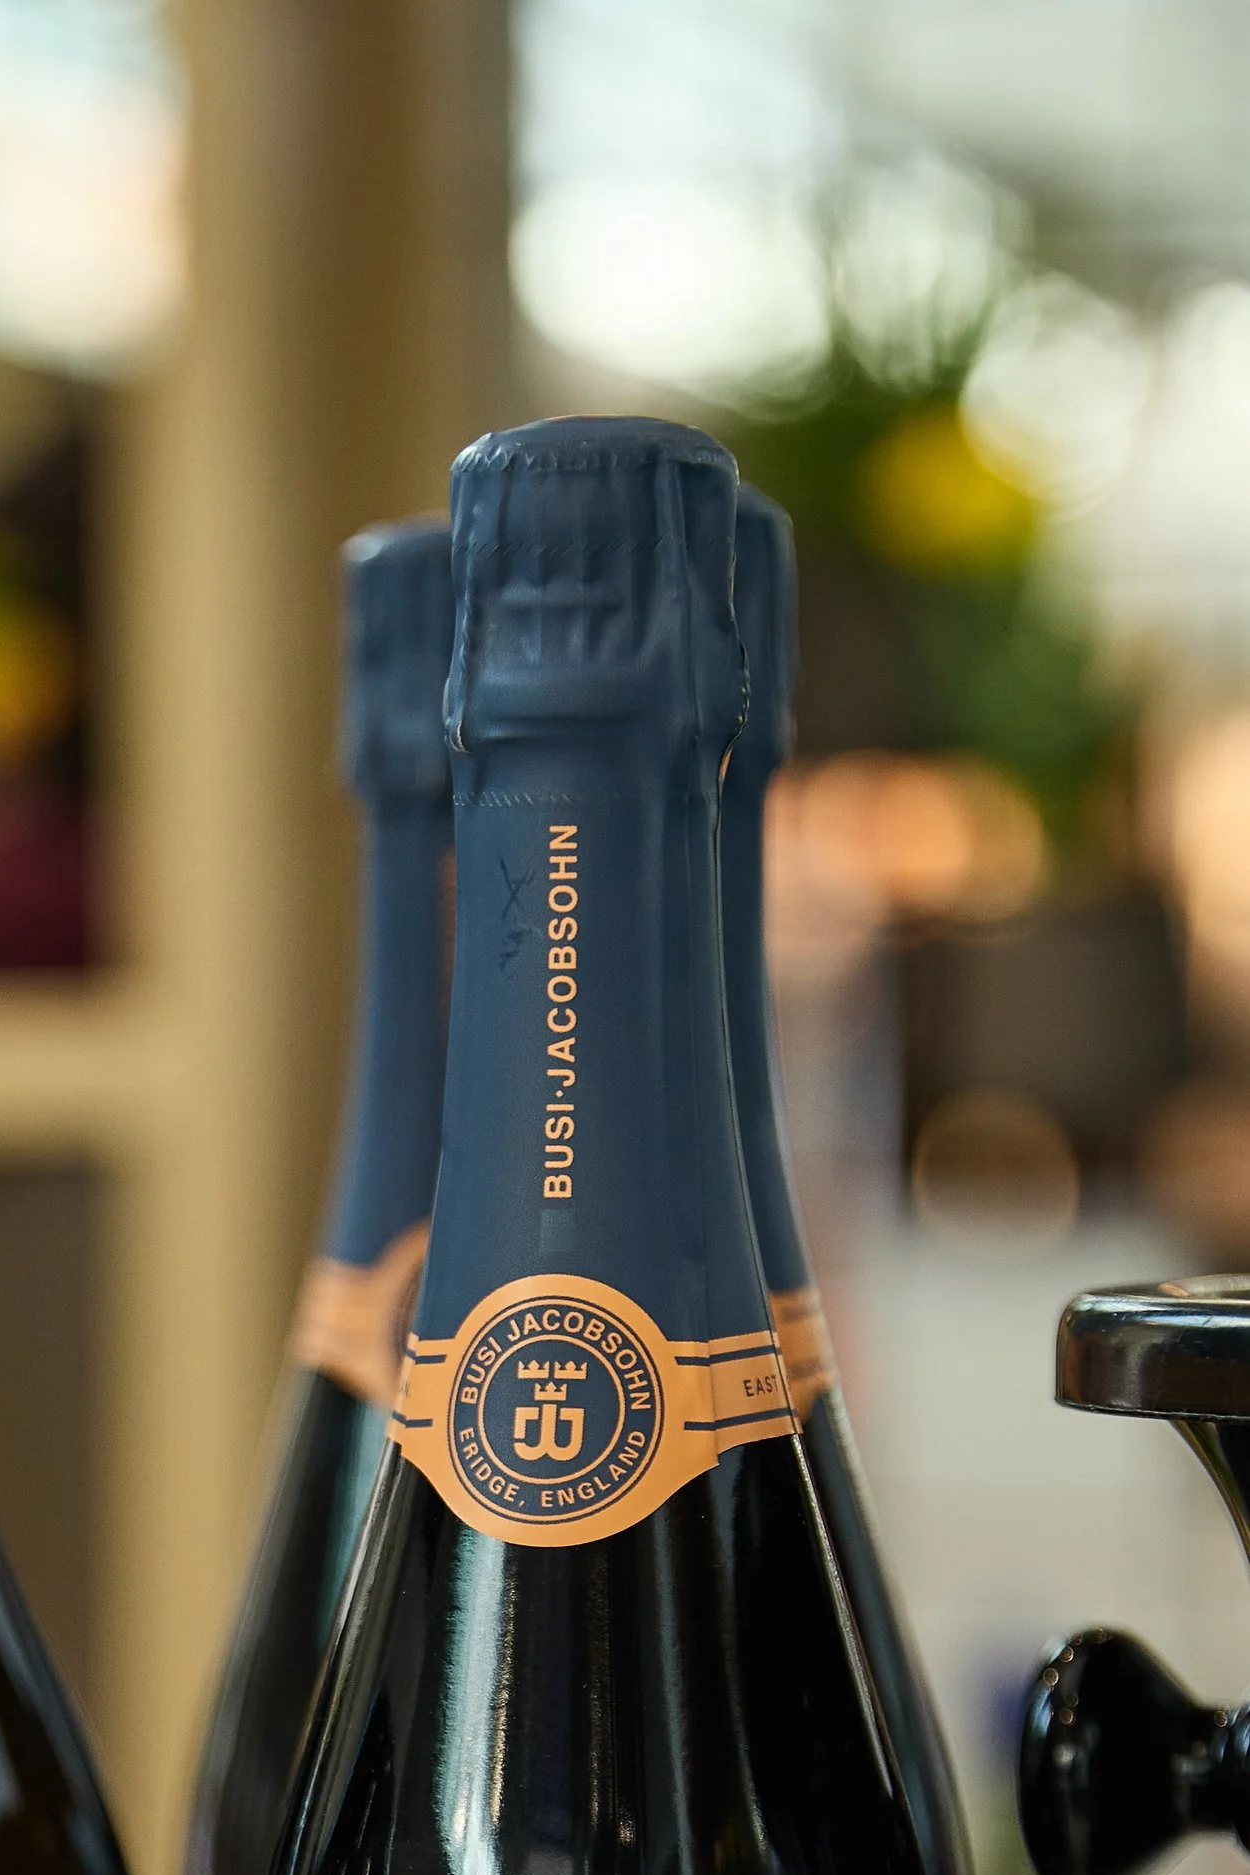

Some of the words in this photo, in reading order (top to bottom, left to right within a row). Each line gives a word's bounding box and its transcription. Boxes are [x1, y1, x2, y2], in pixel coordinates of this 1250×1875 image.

[460, 1336, 502, 1405] BUSI
[506, 1308, 652, 1411] JACOBSOHN
[742, 1374, 780, 1398] EAST
[458, 1426, 526, 1508] ERIDGE,
[539, 1429, 647, 1509] ENGLAND
